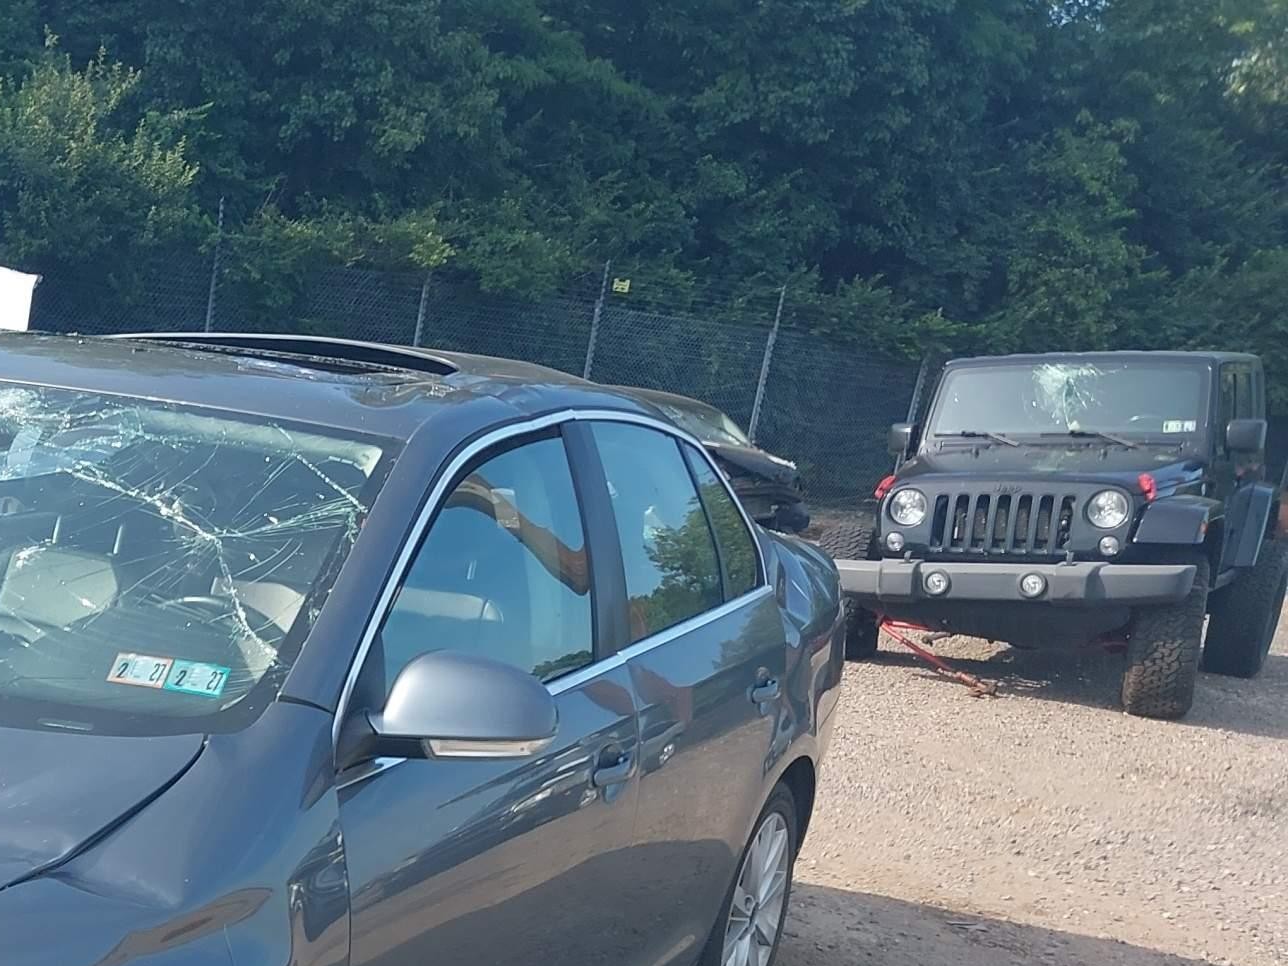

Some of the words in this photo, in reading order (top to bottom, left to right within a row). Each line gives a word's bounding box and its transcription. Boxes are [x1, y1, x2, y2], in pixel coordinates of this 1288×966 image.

[116, 662, 129, 678] 2
[149, 663, 167, 684] 27
[175, 670, 188, 687] 2
[206, 671, 224, 692] 27
